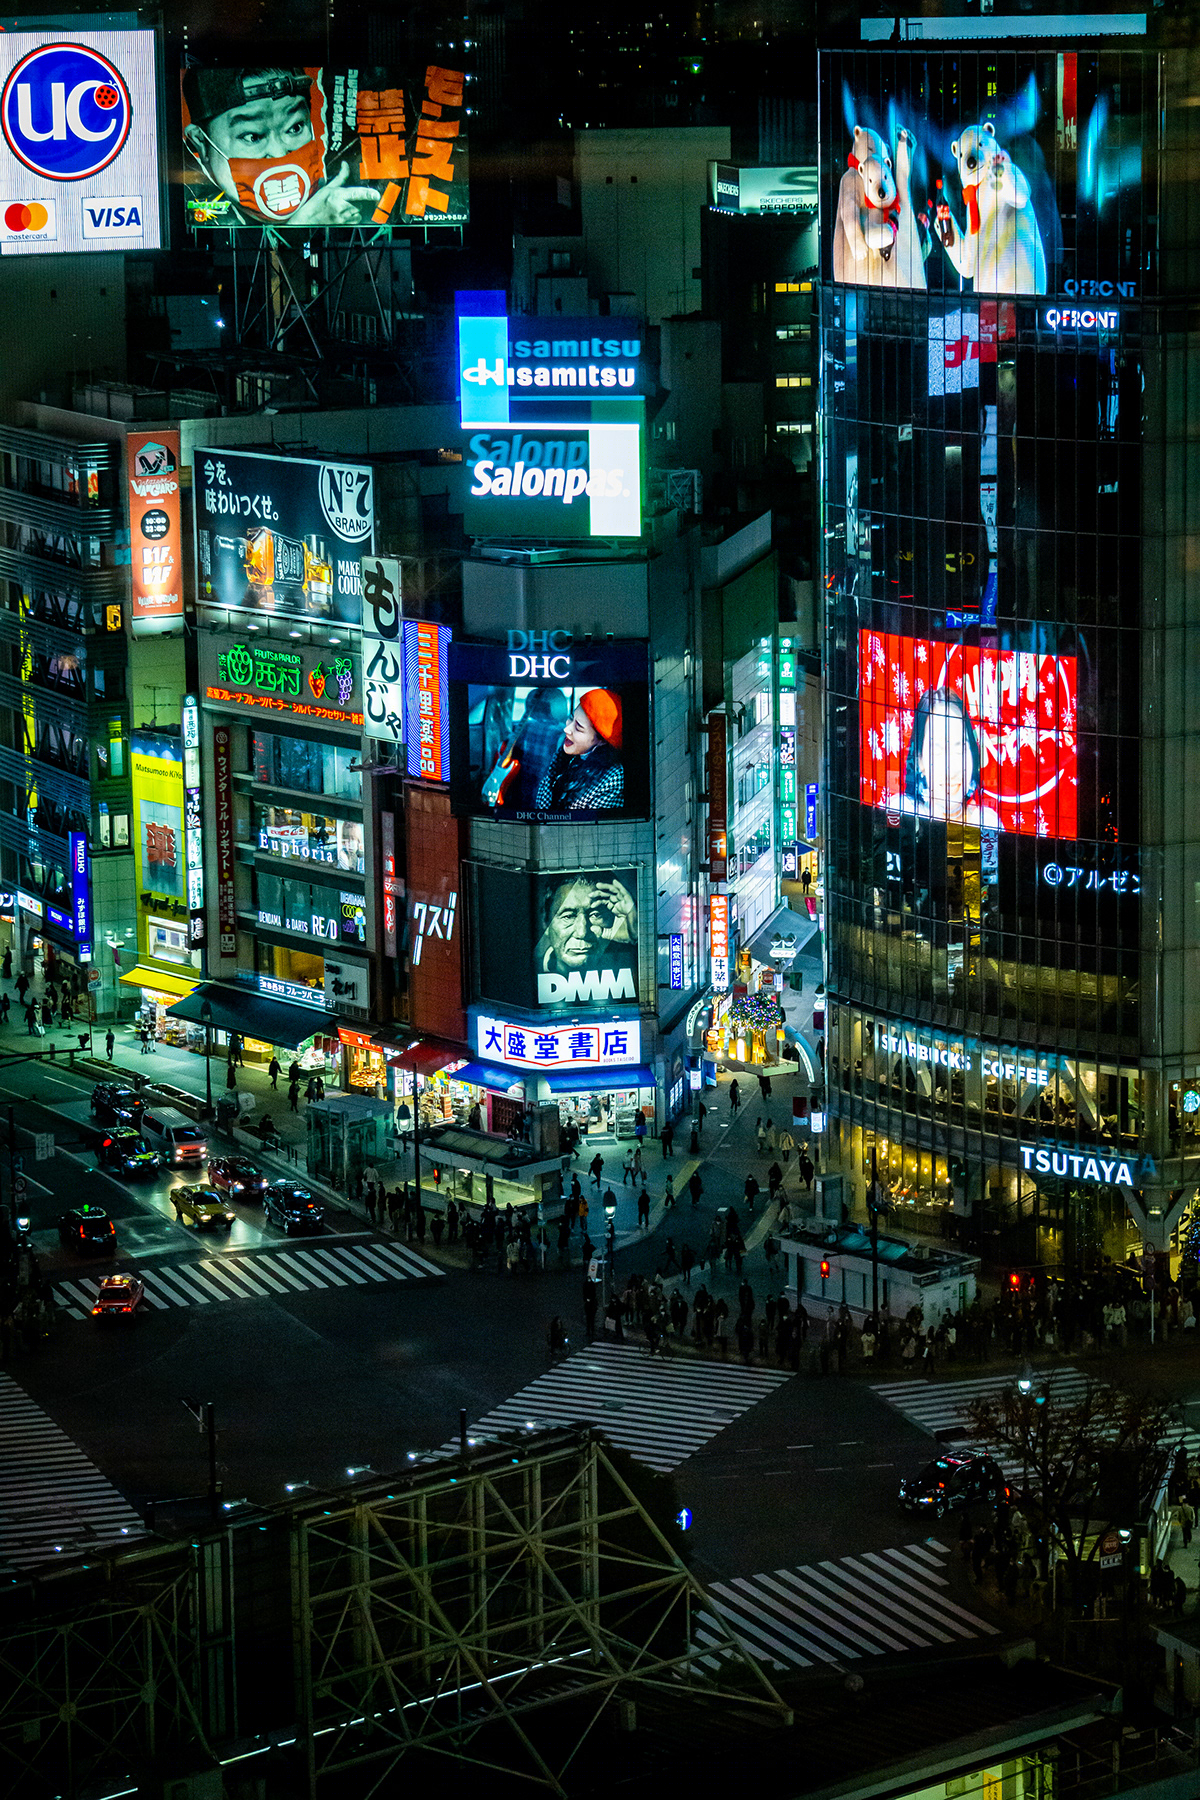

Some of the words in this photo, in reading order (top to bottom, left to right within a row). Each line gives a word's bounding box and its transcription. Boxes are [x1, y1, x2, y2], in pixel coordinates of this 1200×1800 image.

[717, 181, 739, 196] SKECHERS
[85, 207, 141, 228] VISA
[7, 232, 48, 240] mastercard
[1046, 309, 1117, 330] QFRONT
[463, 358, 635, 387] Hisamitsu
[204, 459, 232, 486] 今を、
[130, 480, 178, 497] VANGUARD
[205, 489, 279, 521] 味わいつくせ。
[335, 516, 368, 533] BRAND
[338, 560, 360, 576] MAKE
[363, 560, 402, 740] もんじゃ
[255, 661, 301, 696] 西村
[509, 655, 570, 678] DHC
[418, 632, 436, 773] 三千里薬品
[135, 763, 168, 777] Matsumoto
[169, 770, 183, 779] KiYo
[217, 756, 231, 870] ウィンターフルーツギフト
[516, 812, 536, 820] DHC
[537, 812, 571, 820] Channel
[77, 840, 85, 873] MIZUHO
[260, 832, 333, 863] Euphoria
[78, 898, 86, 934] みずほ銀行
[312, 914, 338, 940] RE/D
[538, 968, 636, 1003] DMM
[484, 1025, 628, 1060] 大盛堂書店
[881, 1034, 972, 1071] STARBUCKS
[983, 1058, 1049, 1086] COFFEE
[1020, 1146, 1133, 1186] TSUTAYA
